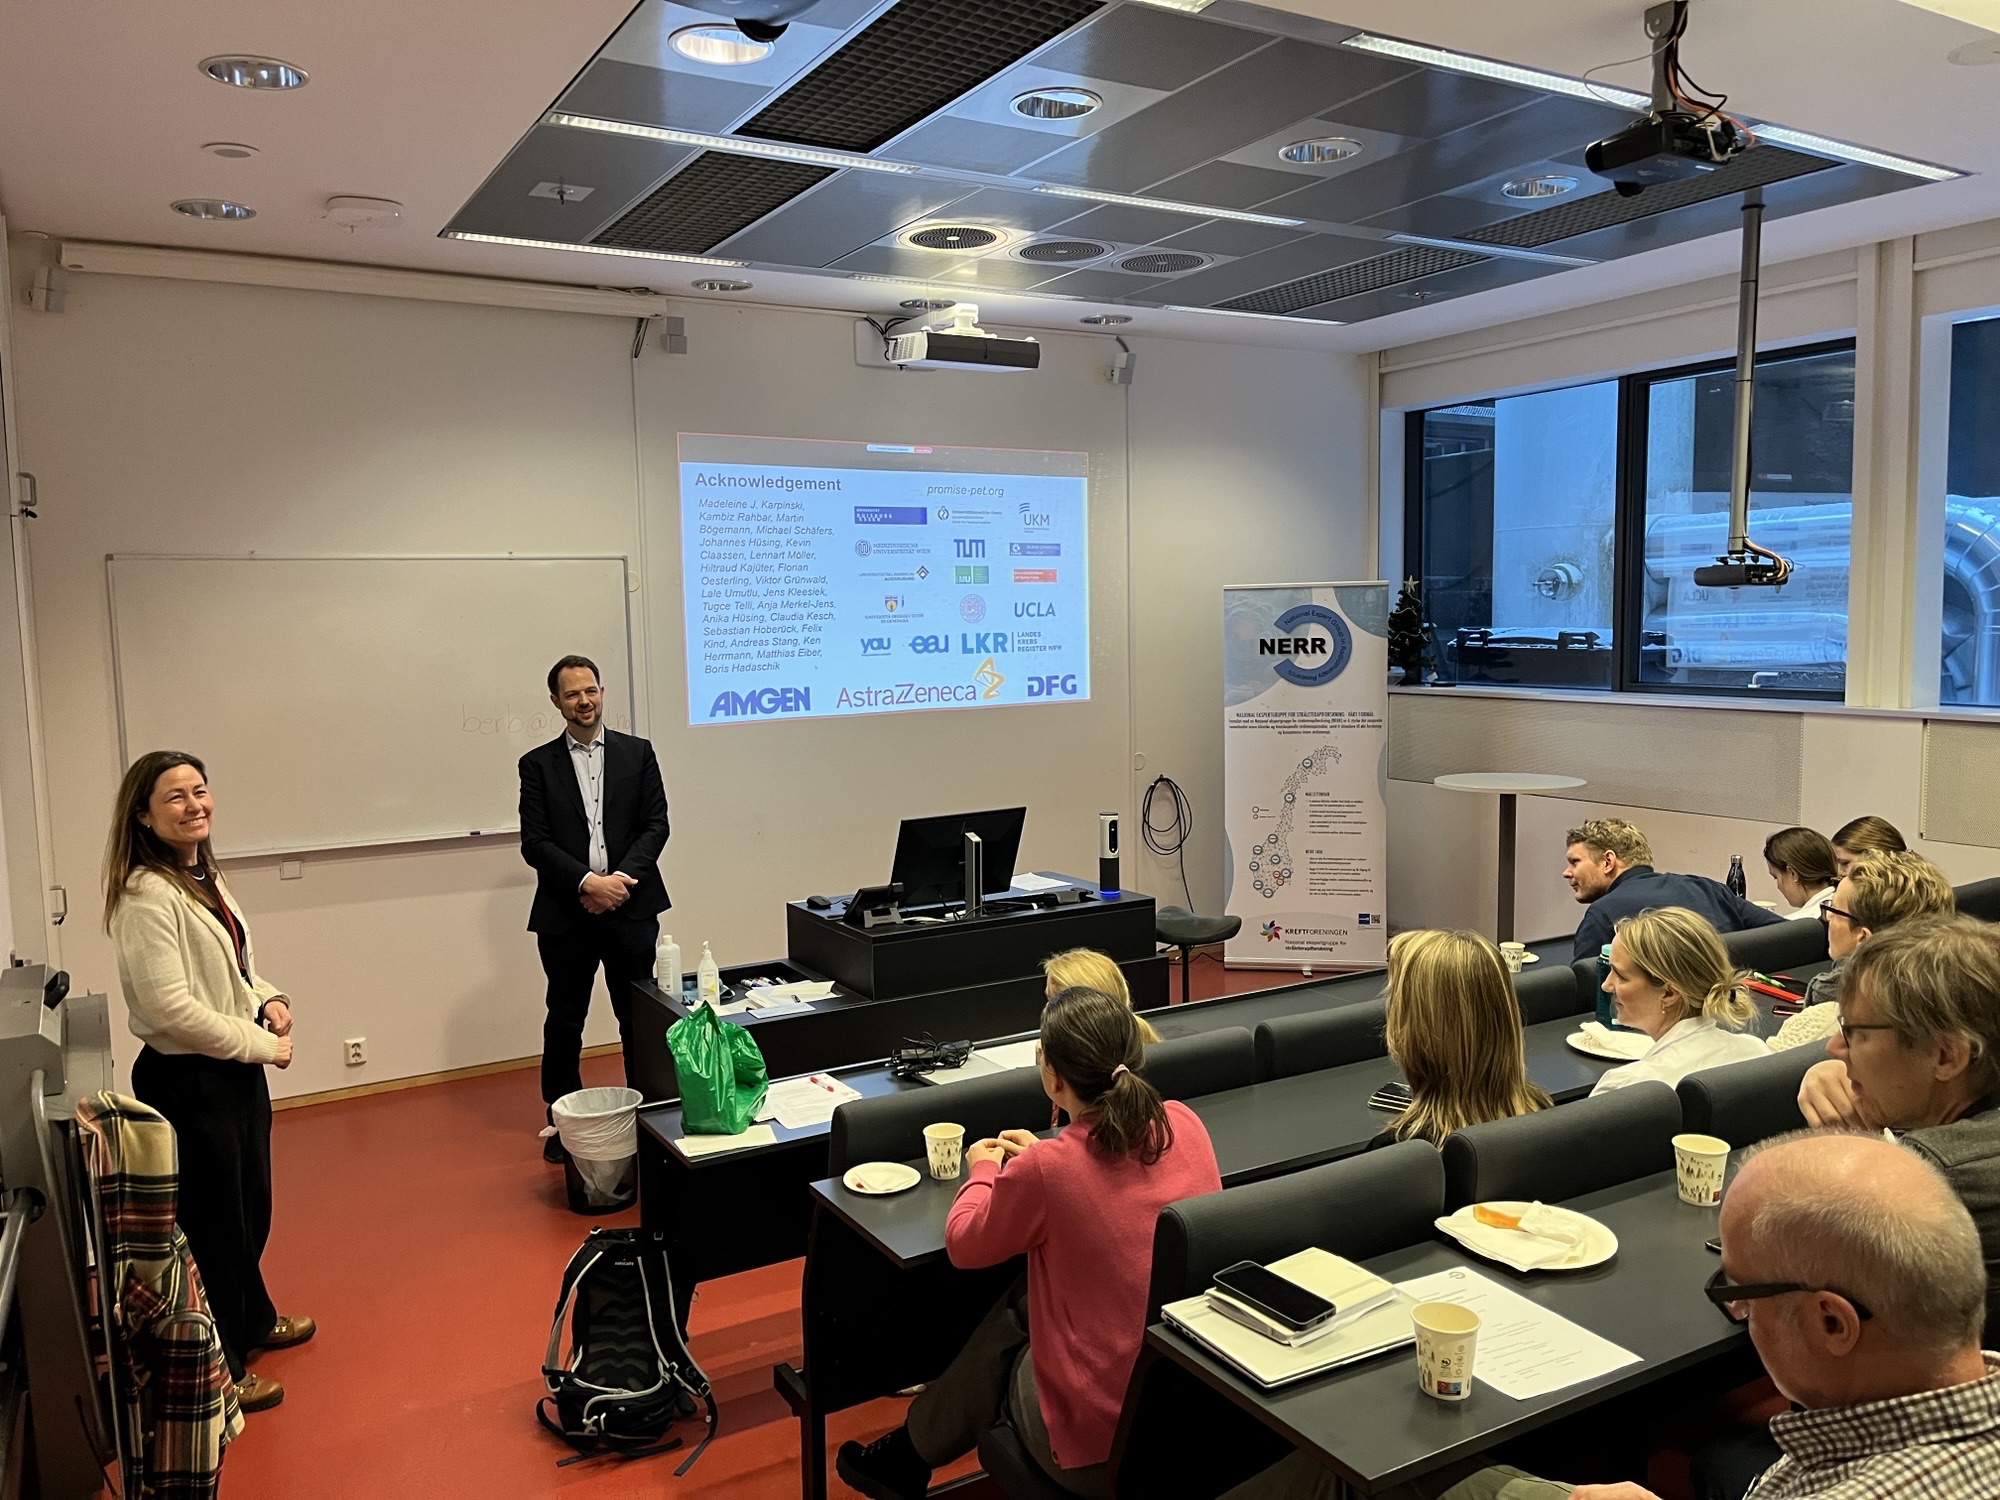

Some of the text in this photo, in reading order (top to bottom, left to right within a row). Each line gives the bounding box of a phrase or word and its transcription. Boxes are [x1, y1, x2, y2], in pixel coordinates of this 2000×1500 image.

[695, 472, 842, 492] Acknowledgement
[927, 485, 1004, 498] promise-pet.org
[699, 499, 805, 511] Madeleine J. Karpinski,
[699, 512, 804, 522] Kambiz Rahbar, Martin
[1024, 514, 1050, 526] UKM
[699, 525, 835, 536] Bögemann, Michael Schäfers,
[699, 538, 811, 549] Johannes Hüsing, Kevin
[954, 539, 985, 558] TUM
[700, 551, 816, 561] Claassen, Lennart Möller,
[700, 563, 808, 574] Hiltraud Kajüter, Florian
[701, 575, 828, 586] Oesterling, Viktor Grünwald,
[701, 587, 828, 598] Lale Umutlu, Jens Kleesiek,
[703, 600, 836, 612] Tugce Telli, Anja Merkel-Jens,
[1014, 602, 1056, 618] UCLA
[702, 612, 836, 624] Anika Hüsing, Claudia Kesch,
[1284, 610, 1310, 625] National
[1312, 610, 1332, 621] Expert
[1330, 620, 1344, 638] Group
[703, 624, 822, 636] Sebastian Hoberück, Felix
[704, 636, 821, 649] Kind, Andreas Stang, Ken
[961, 632, 1008, 654] LKR
[1260, 638, 1327, 655] NERR
[704, 649, 823, 662] Herrmann, Matthias Eiber,
[704, 662, 780, 674] Boris Hadaschik
[1027, 674, 1077, 697] DFG
[836, 683, 977, 708] AstraZeneca
[709, 686, 811, 718] AMGEN
[1285, 928, 1348, 936] KREFTFORENINGEN
